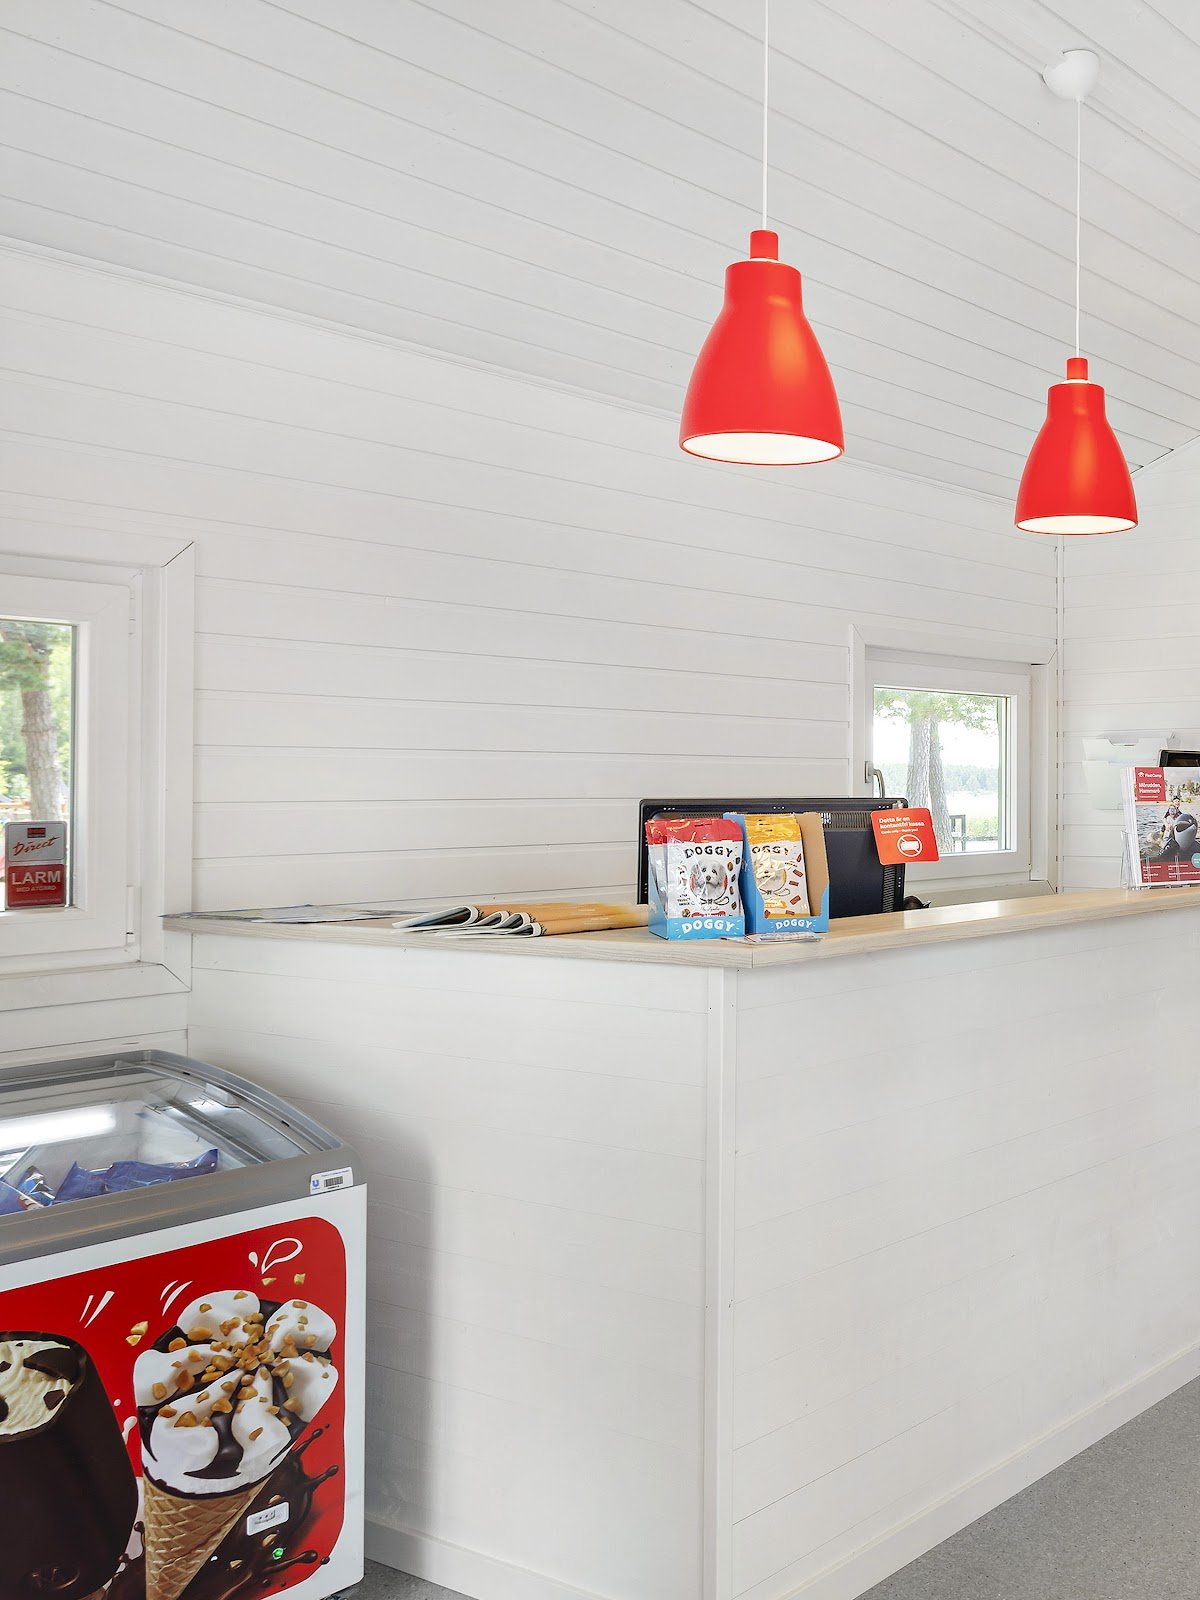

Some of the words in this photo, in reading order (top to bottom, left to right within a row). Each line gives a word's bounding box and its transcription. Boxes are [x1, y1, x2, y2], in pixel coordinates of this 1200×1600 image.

[13, 837, 60, 856] Direct
[684, 846, 733, 858] DOGGY
[751, 845, 792, 856] OGGY
[12, 871, 61, 884] LARM
[682, 919, 735, 934] DOGGY
[775, 918, 813, 930] DOGGY
